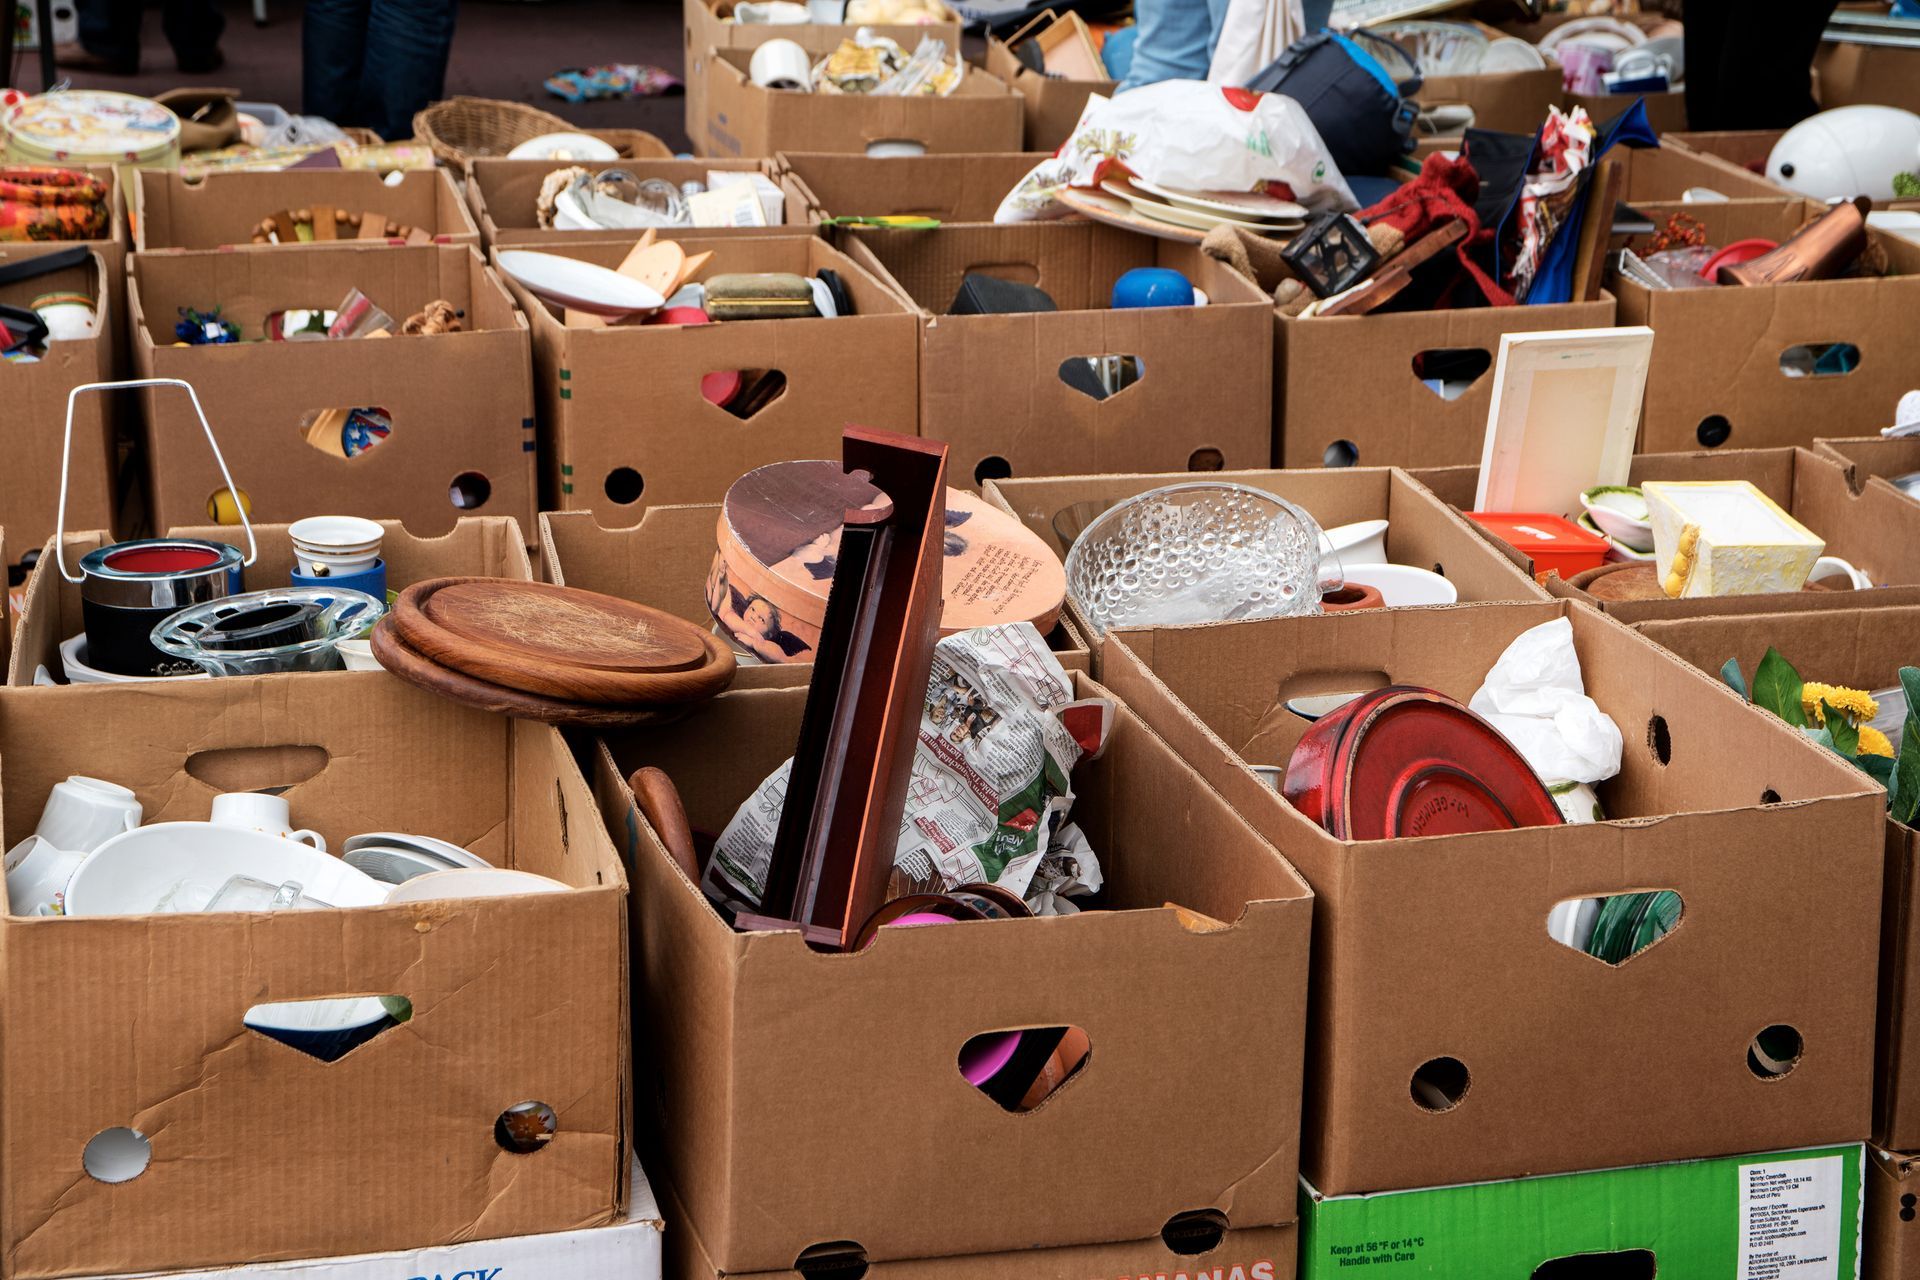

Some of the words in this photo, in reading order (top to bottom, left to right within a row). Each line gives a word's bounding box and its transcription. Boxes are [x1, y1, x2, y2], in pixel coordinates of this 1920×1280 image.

[998, 832, 1023, 846] NEU!
[1330, 1245, 1352, 1255] Keep
[1355, 1243, 1364, 1253] at
[1391, 1241, 1400, 1250] or
[1402, 1238, 1412, 1248] 14
[1340, 1256, 1370, 1267] Handle
[1372, 1254, 1392, 1264] with
[1394, 1252, 1415, 1262] Care
